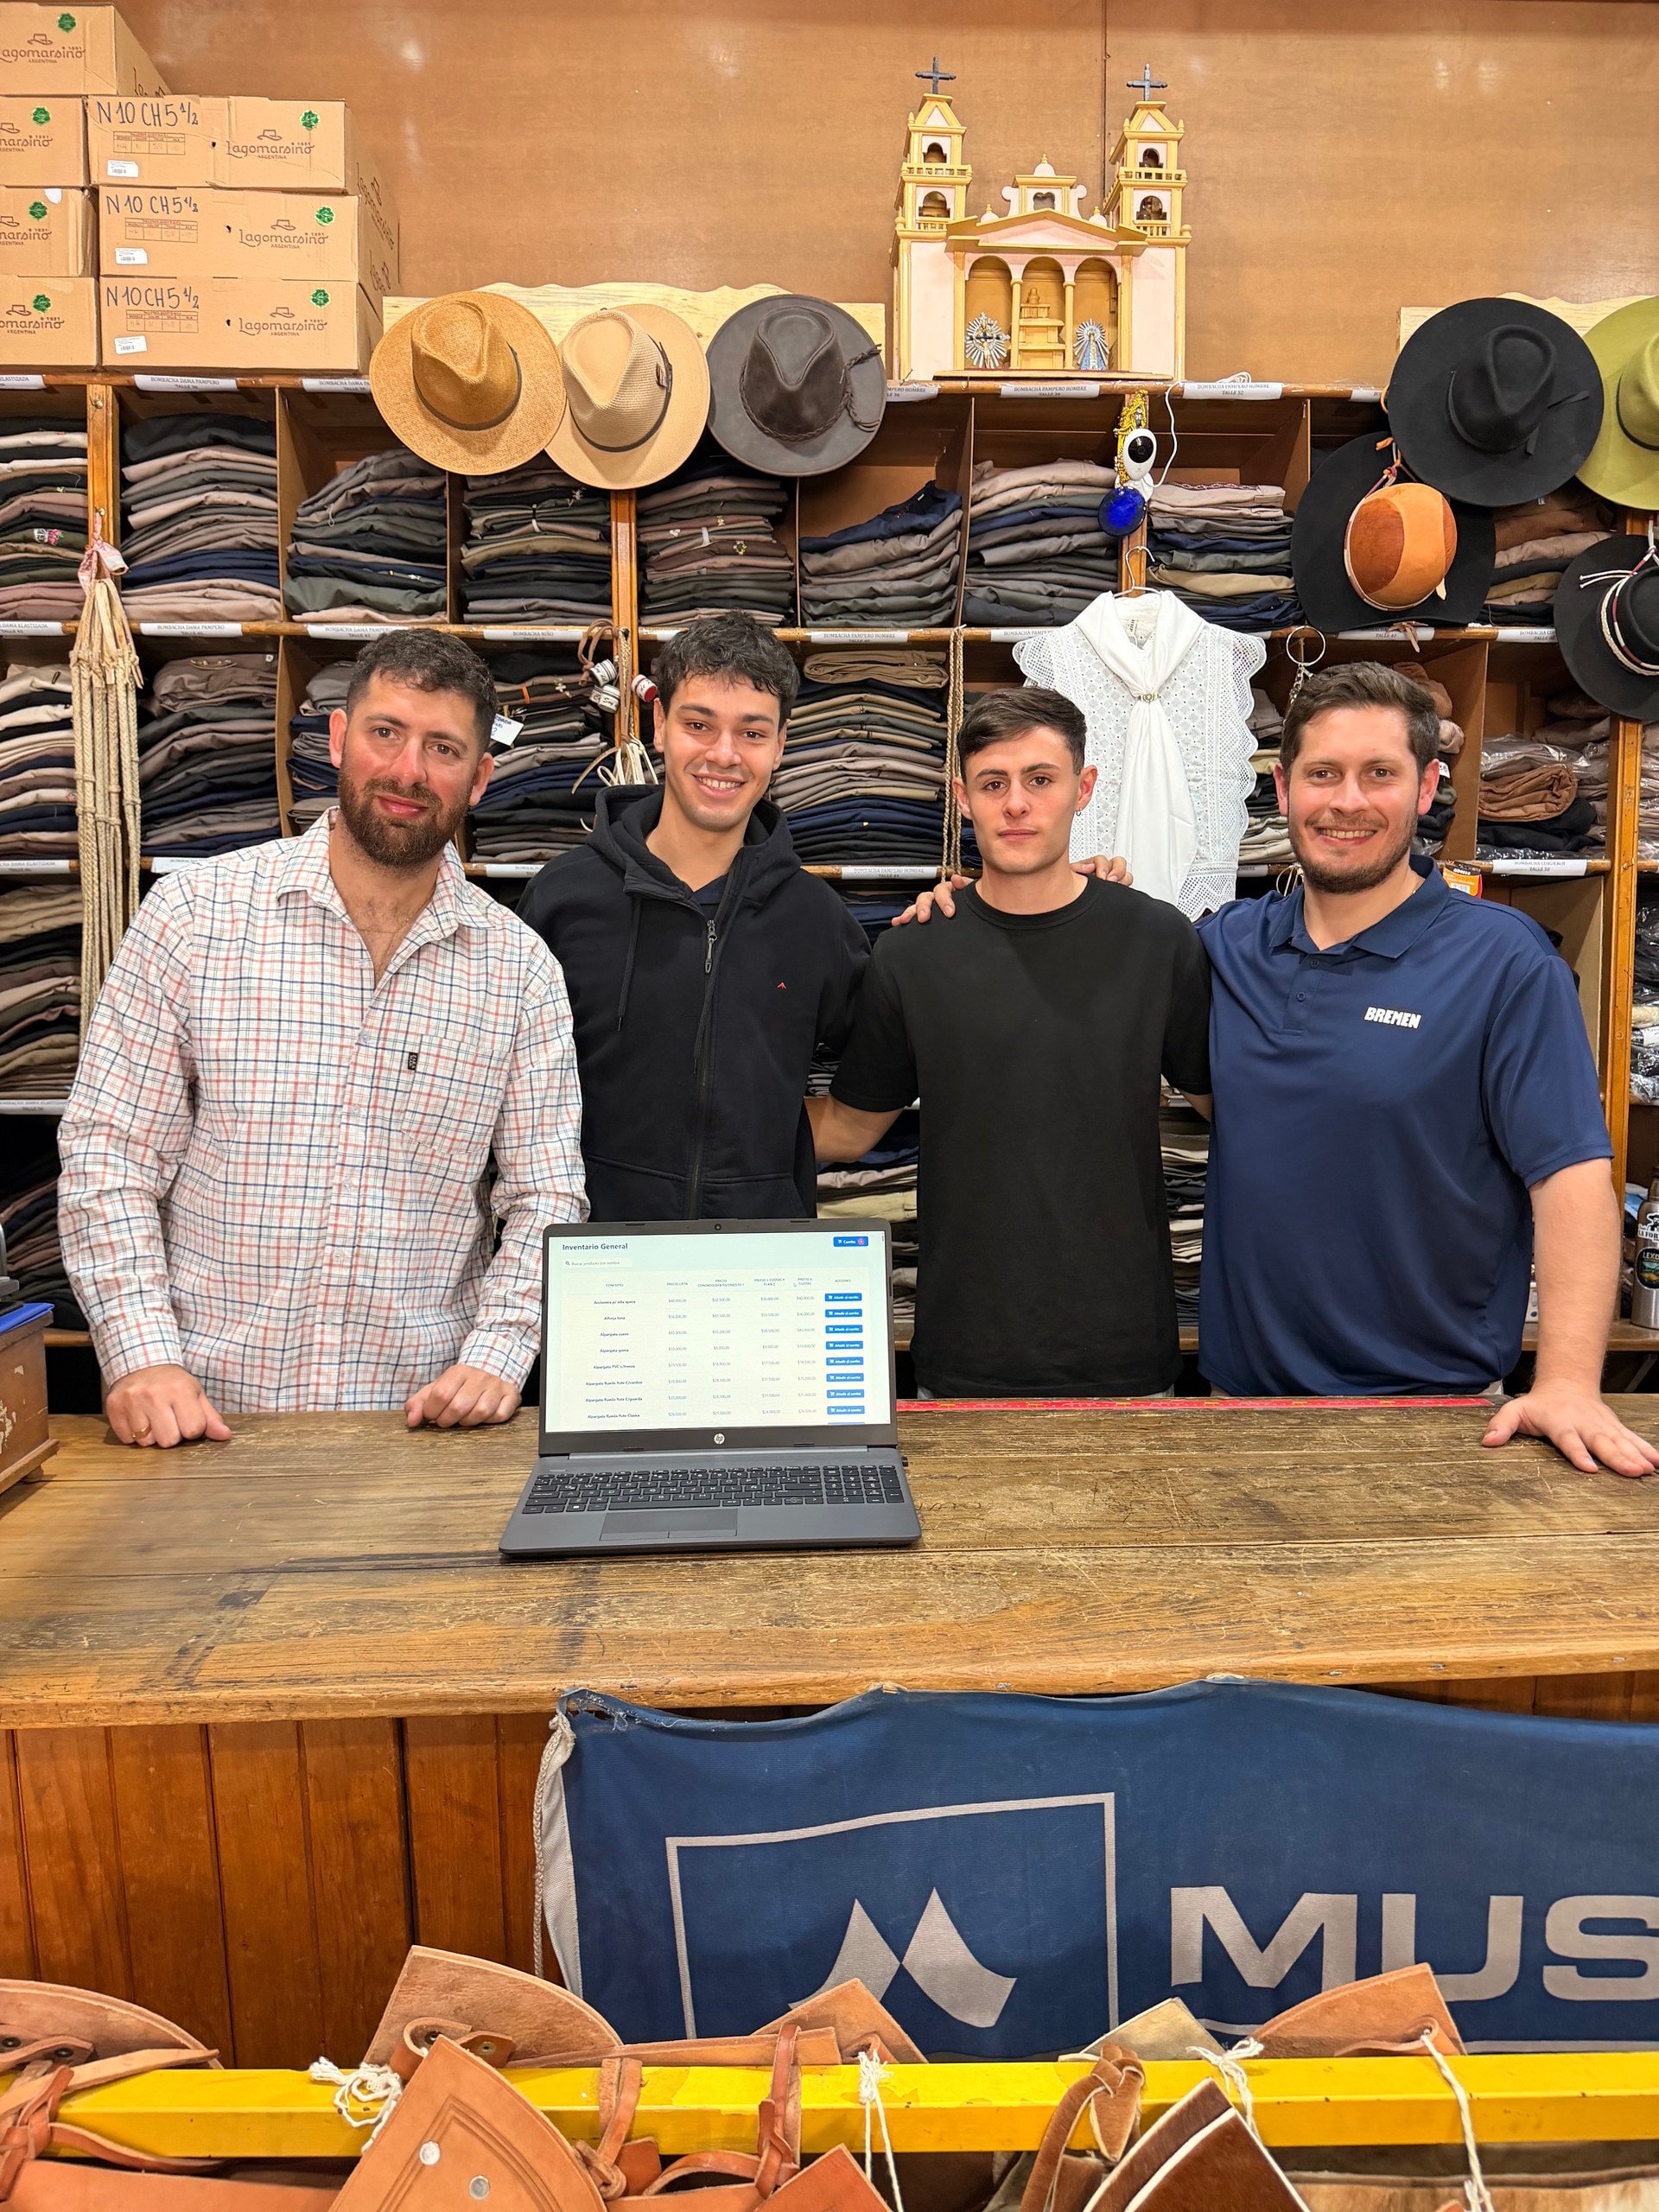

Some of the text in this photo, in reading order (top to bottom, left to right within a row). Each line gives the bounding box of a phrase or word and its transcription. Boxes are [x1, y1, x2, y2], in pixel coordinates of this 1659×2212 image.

[226, 141, 315, 159] Lagomarsino
[239, 229, 328, 248] Lagomarsino
[239, 318, 327, 336] Lagomarsino
[1363, 1007, 1421, 1029] BREMEN
[1171, 1885, 1659, 2001] MUS
